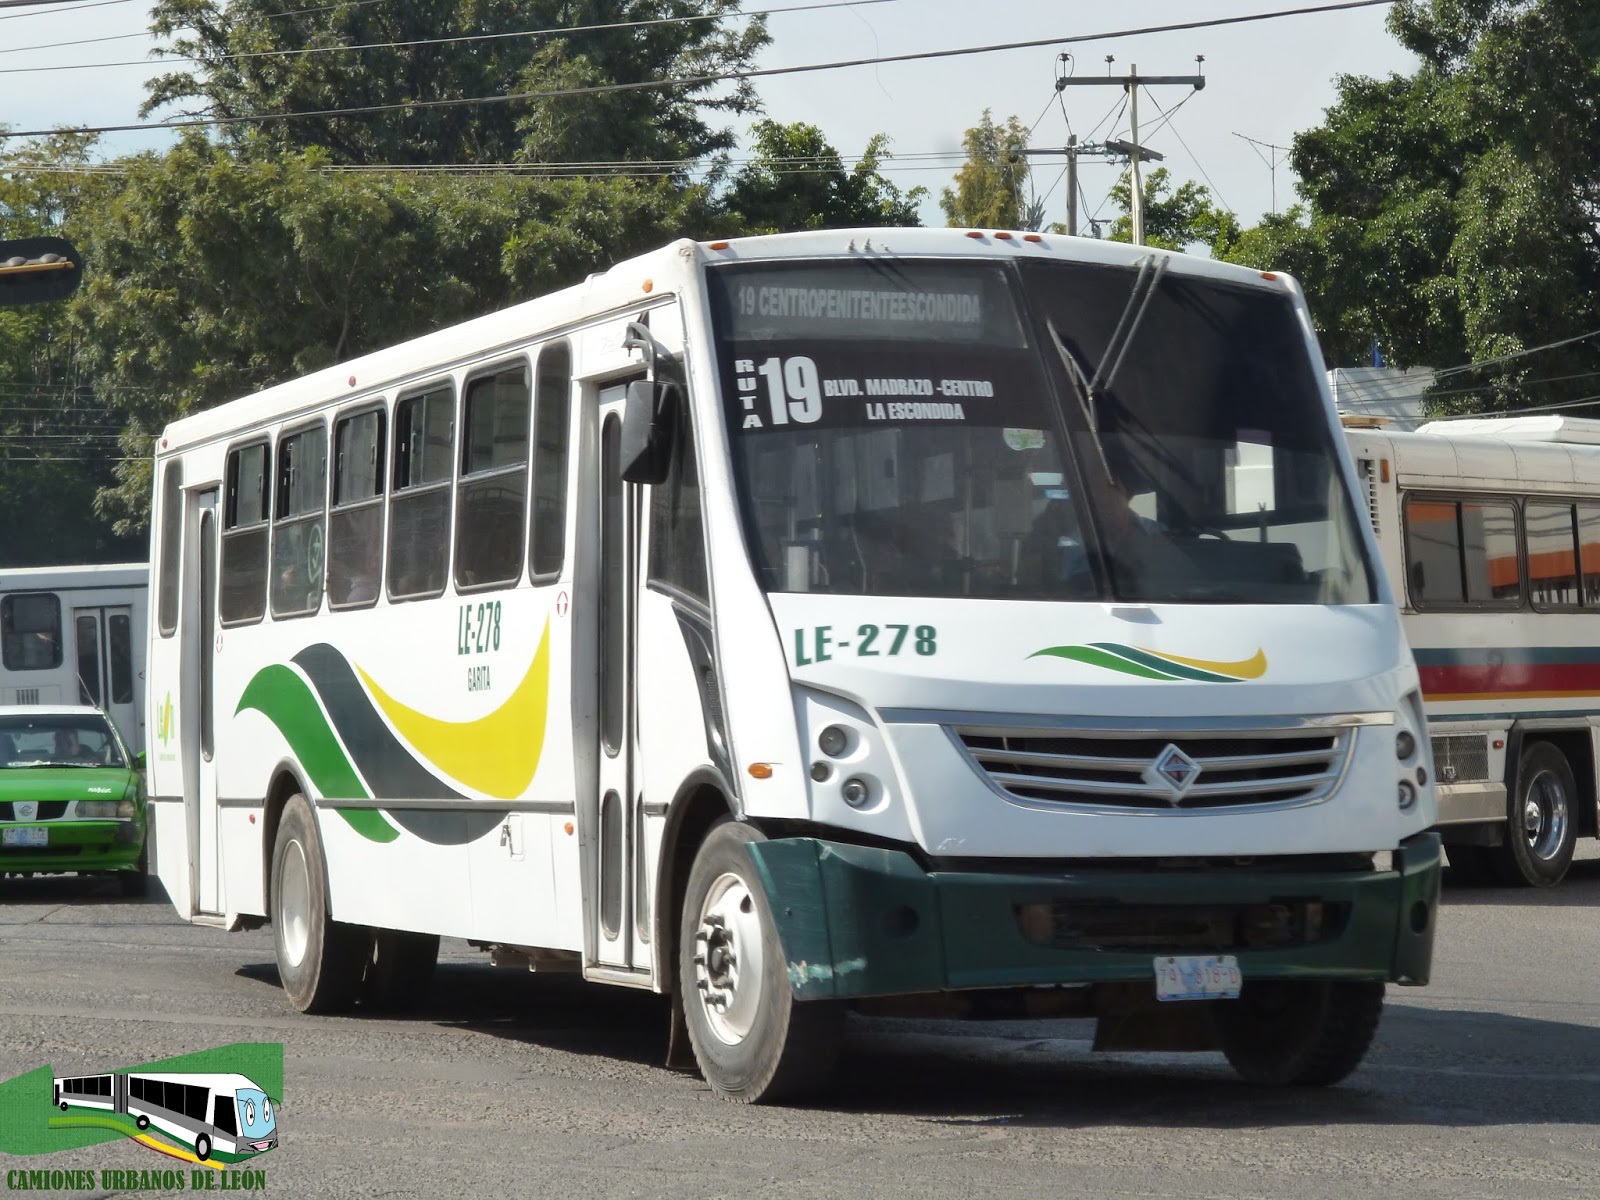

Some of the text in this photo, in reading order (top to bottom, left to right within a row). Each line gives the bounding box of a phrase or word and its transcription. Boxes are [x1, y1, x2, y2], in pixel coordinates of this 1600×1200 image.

[738, 286, 755, 316] 19
[734, 359, 764, 429] RUTA
[758, 356, 823, 425] 19
[824, 379, 864, 397] BLVD.
[865, 379, 934, 397] MADRAZO
[866, 403, 966, 420] LA ESCONDIDA
[457, 600, 502, 655] LE-278
[794, 624, 937, 667] LE-278
[467, 665, 491, 692] GARITA
